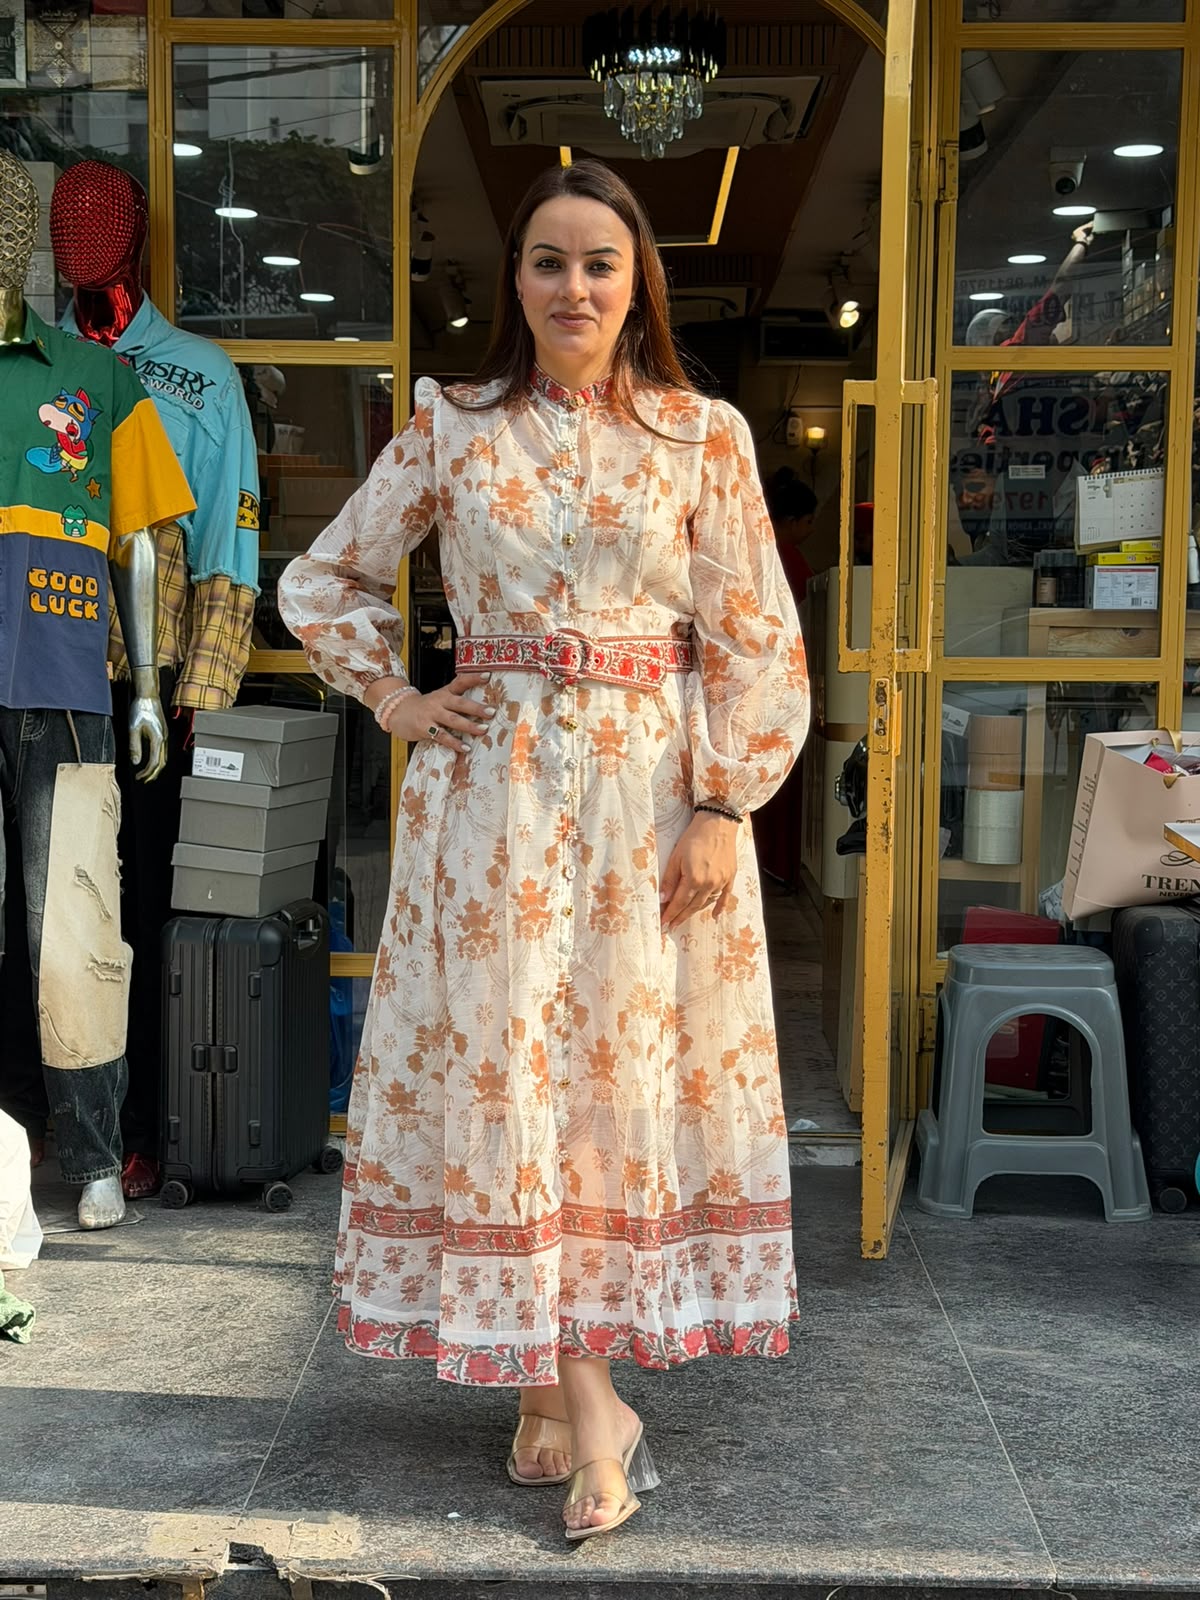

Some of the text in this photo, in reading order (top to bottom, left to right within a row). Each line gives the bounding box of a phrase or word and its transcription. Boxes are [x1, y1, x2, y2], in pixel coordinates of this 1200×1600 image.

[123, 346, 217, 397] MISERY
[148, 377, 205, 411] WORLD
[28, 567, 98, 597] GOOD
[29, 591, 99, 620] LUCK
